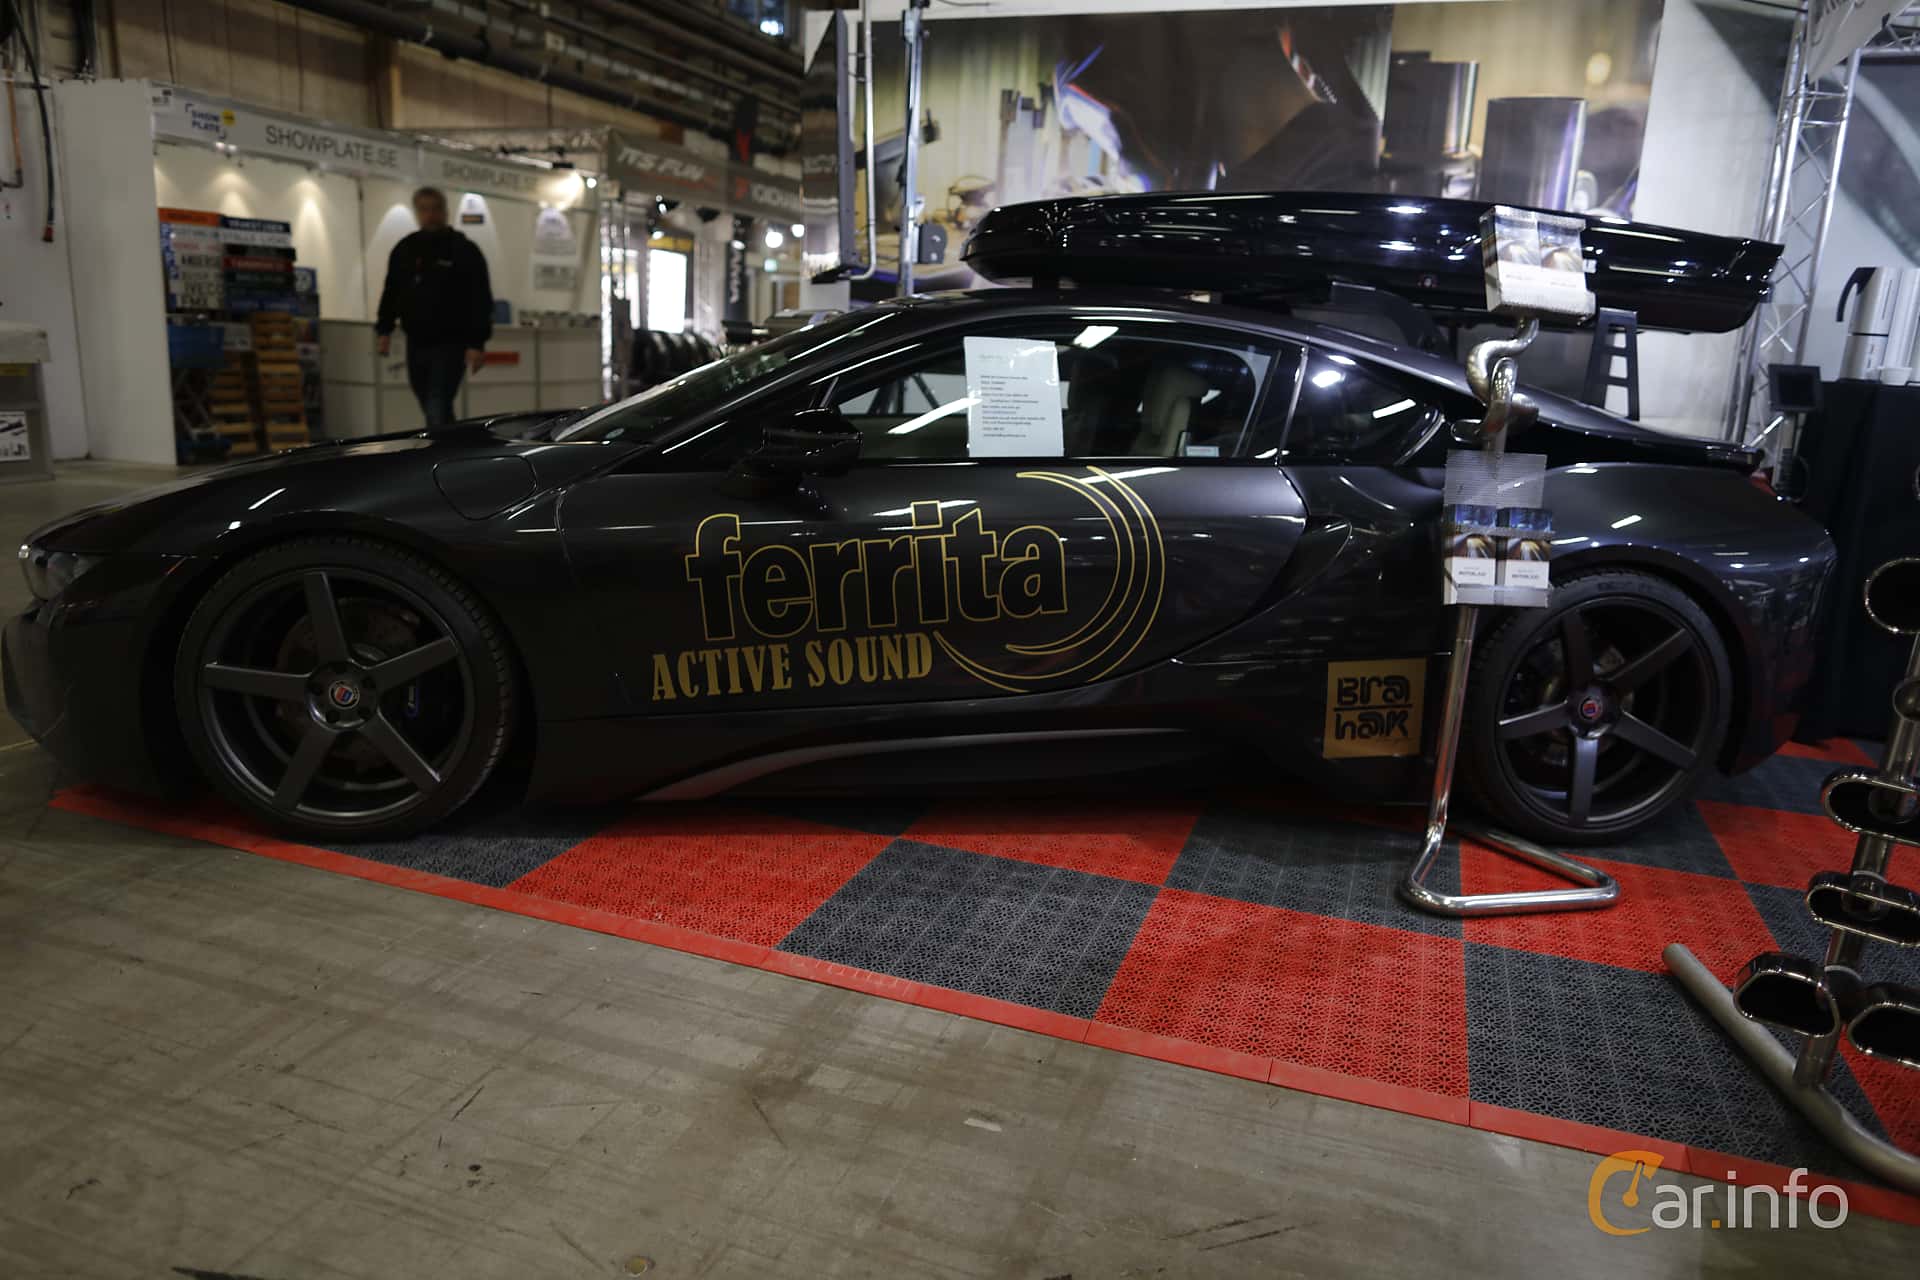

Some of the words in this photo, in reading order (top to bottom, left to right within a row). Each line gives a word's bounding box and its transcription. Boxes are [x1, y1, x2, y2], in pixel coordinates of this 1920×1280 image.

[265, 124, 398, 167] SHOWPLATE.SE
[685, 500, 1068, 640] ferrita
[652, 643, 793, 700] ACTIVE
[806, 634, 933, 687] SOUND
